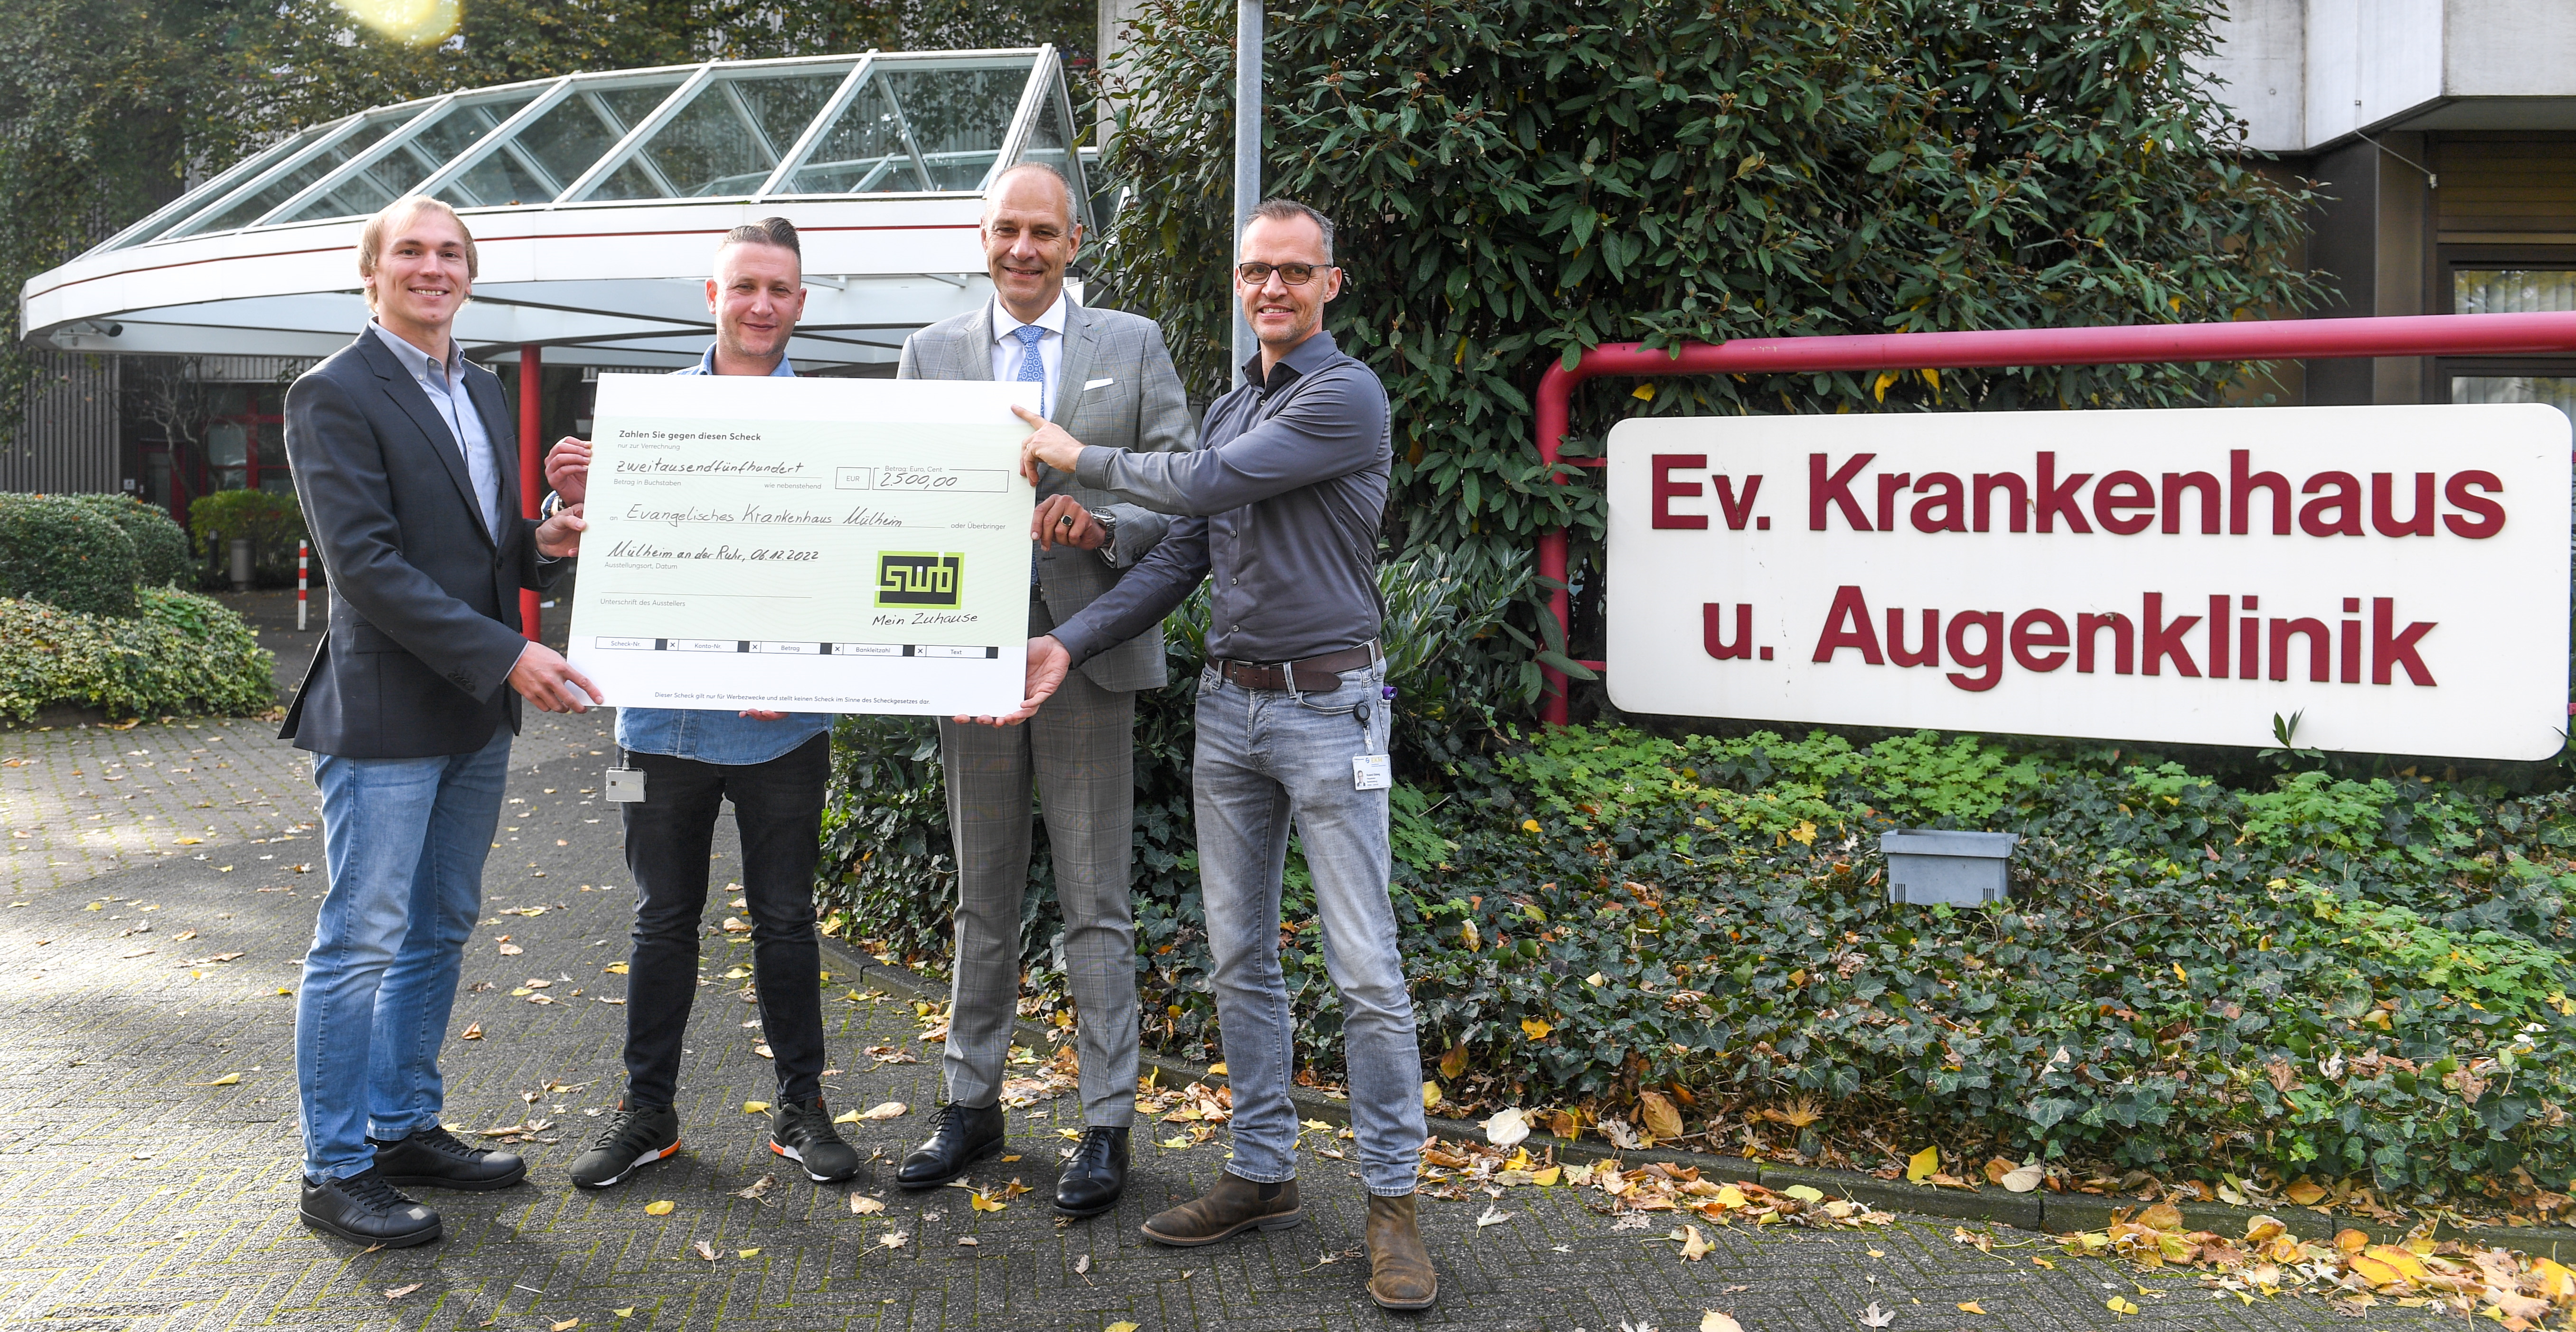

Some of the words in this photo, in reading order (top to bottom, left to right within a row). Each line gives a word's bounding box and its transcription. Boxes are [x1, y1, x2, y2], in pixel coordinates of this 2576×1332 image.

[619, 430, 649, 439] Zahlen
[652, 431, 666, 439] Sie
[668, 432, 696, 441] gegen
[698, 432, 727, 441] diesen
[729, 433, 761, 441] Scheck
[640, 443, 680, 451] Verrechnung
[613, 479, 635, 487] Betrag
[880, 472, 958, 490] 2.500,00
[1650, 453, 1771, 530] Ev.
[1808, 449, 2506, 539] Krankenhaus
[627, 504, 734, 528] Evangelisches
[742, 503, 832, 524] Krankenhaus
[842, 506, 903, 527] Mülheim
[967, 521, 1006, 530] Überbringer
[607, 540, 673, 558] Mülheim
[677, 550, 692, 559] an
[694, 547, 714, 559] der
[716, 545, 746, 563] Ruhr,
[750, 548, 819, 561] 06.12.2022
[872, 614, 905, 626] Mein
[911, 612, 978, 625] Zuhause
[1702, 602, 1774, 662] u.
[1812, 585, 2438, 692] Augenklinik
[873, 697, 918, 705] Scheckgesetzes
